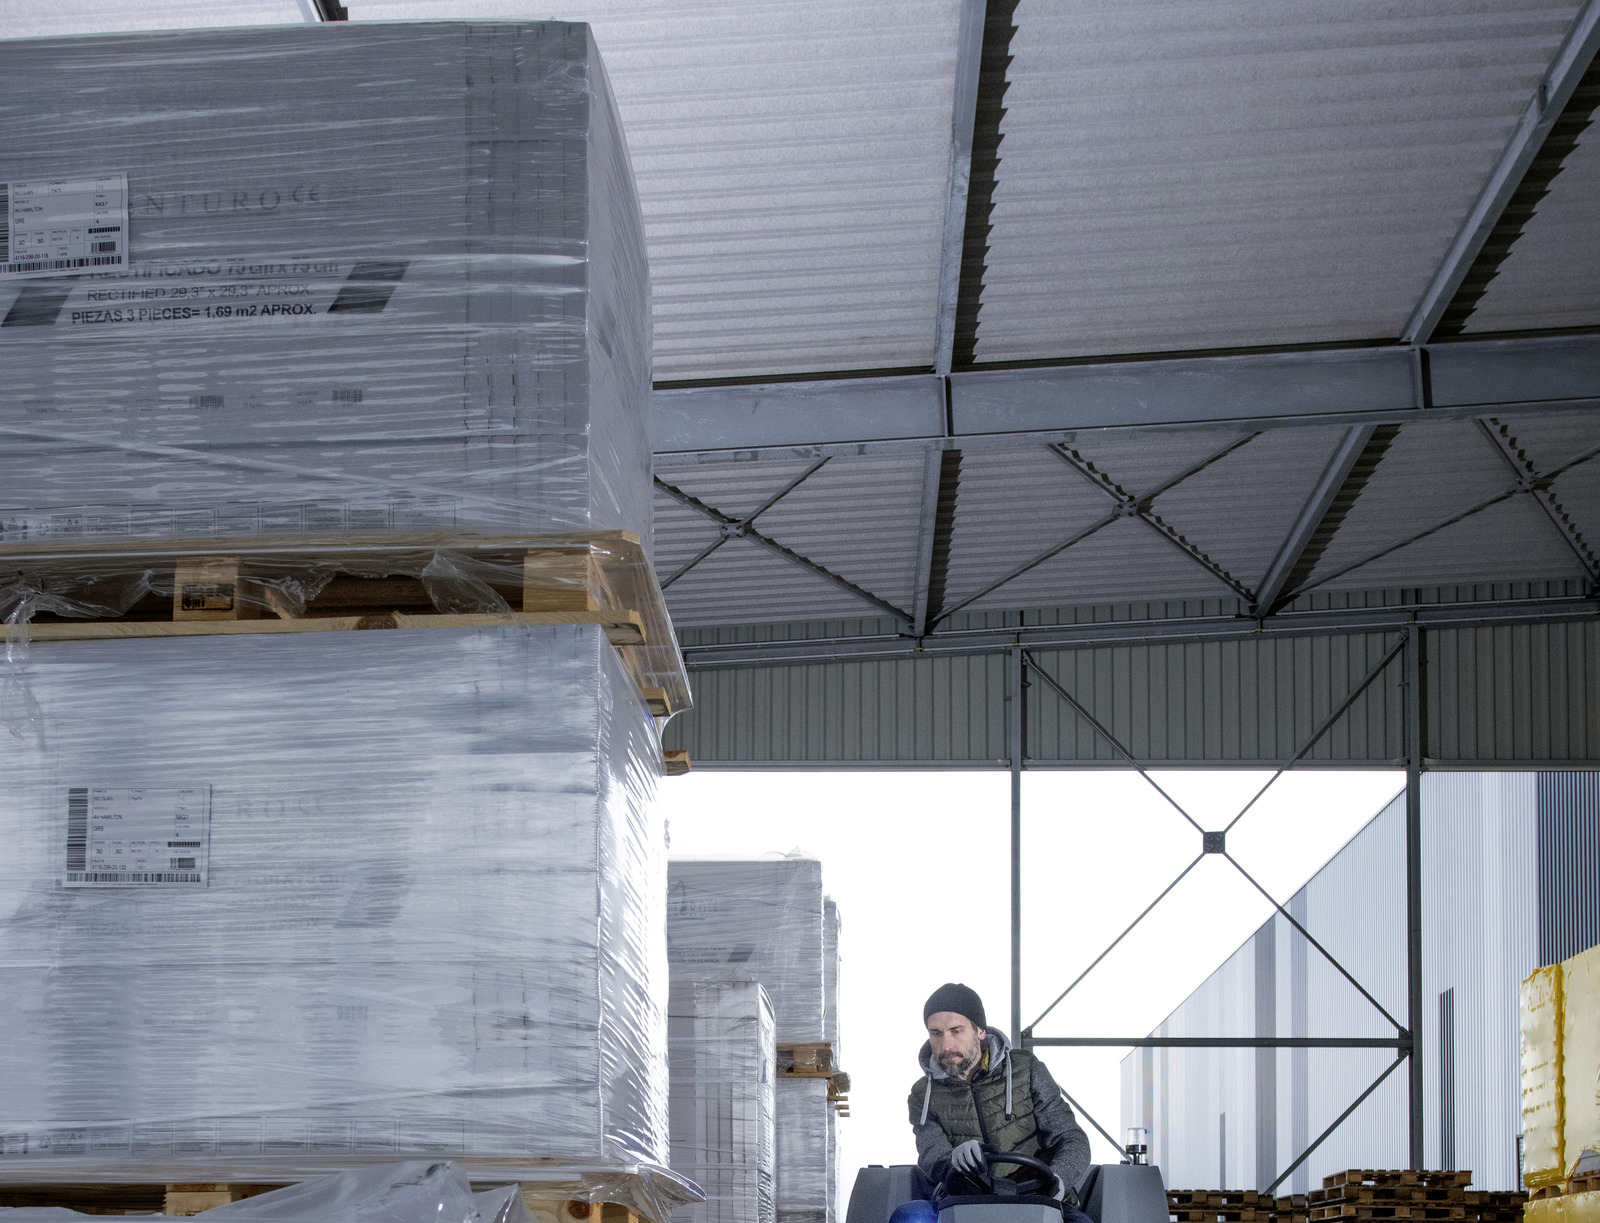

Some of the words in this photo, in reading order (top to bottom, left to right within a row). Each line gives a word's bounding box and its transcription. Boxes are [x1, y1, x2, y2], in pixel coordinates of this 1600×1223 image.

[87, 287, 166, 301] RECTIFIED
[72, 310, 123, 325] PIEZAS
[126, 309, 136, 322] 3
[204, 305, 233, 319] 1,69
[235, 304, 257, 317] m2
[260, 303, 317, 316] APROX.
